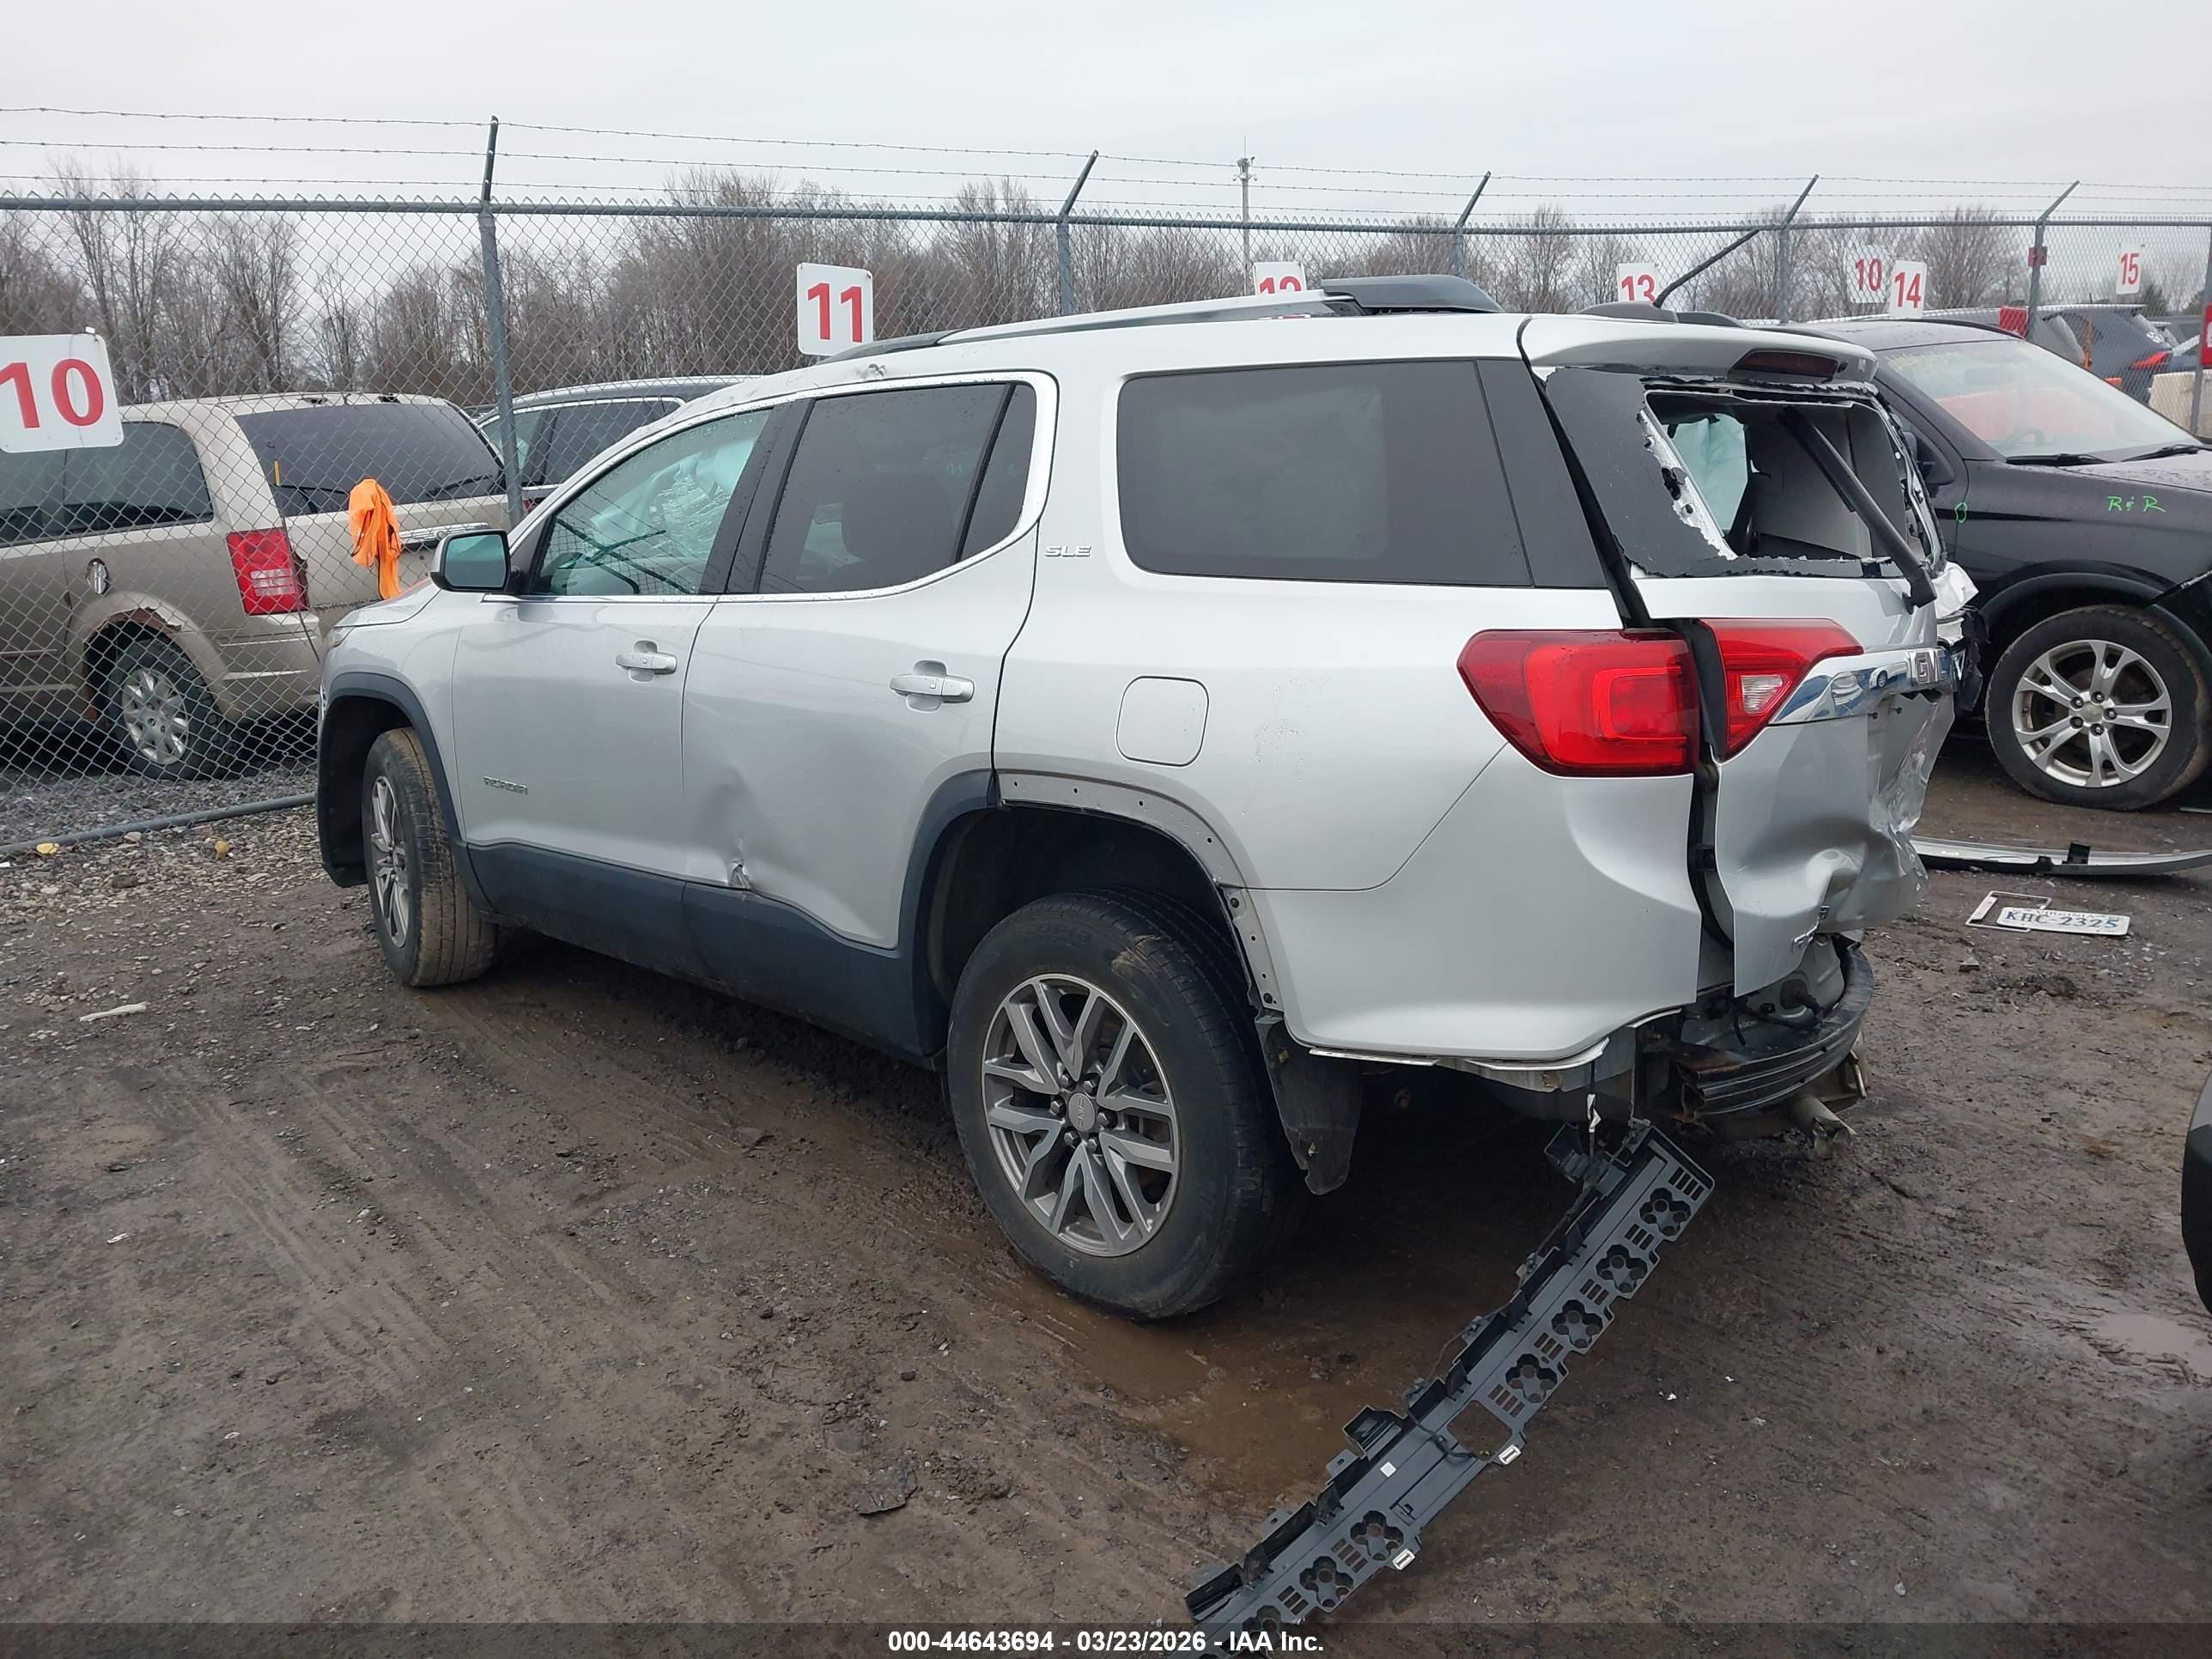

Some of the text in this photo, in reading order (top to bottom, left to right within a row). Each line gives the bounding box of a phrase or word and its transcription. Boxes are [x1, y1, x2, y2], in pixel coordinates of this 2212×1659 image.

[1855, 258, 1882, 291] 10
[2121, 252, 2140, 285] 15
[1621, 274, 1655, 301] 13
[1894, 272, 1922, 308] 14
[807, 282, 863, 343] 11
[0, 359, 104, 428] 10
[1044, 545, 1091, 557] SLE
